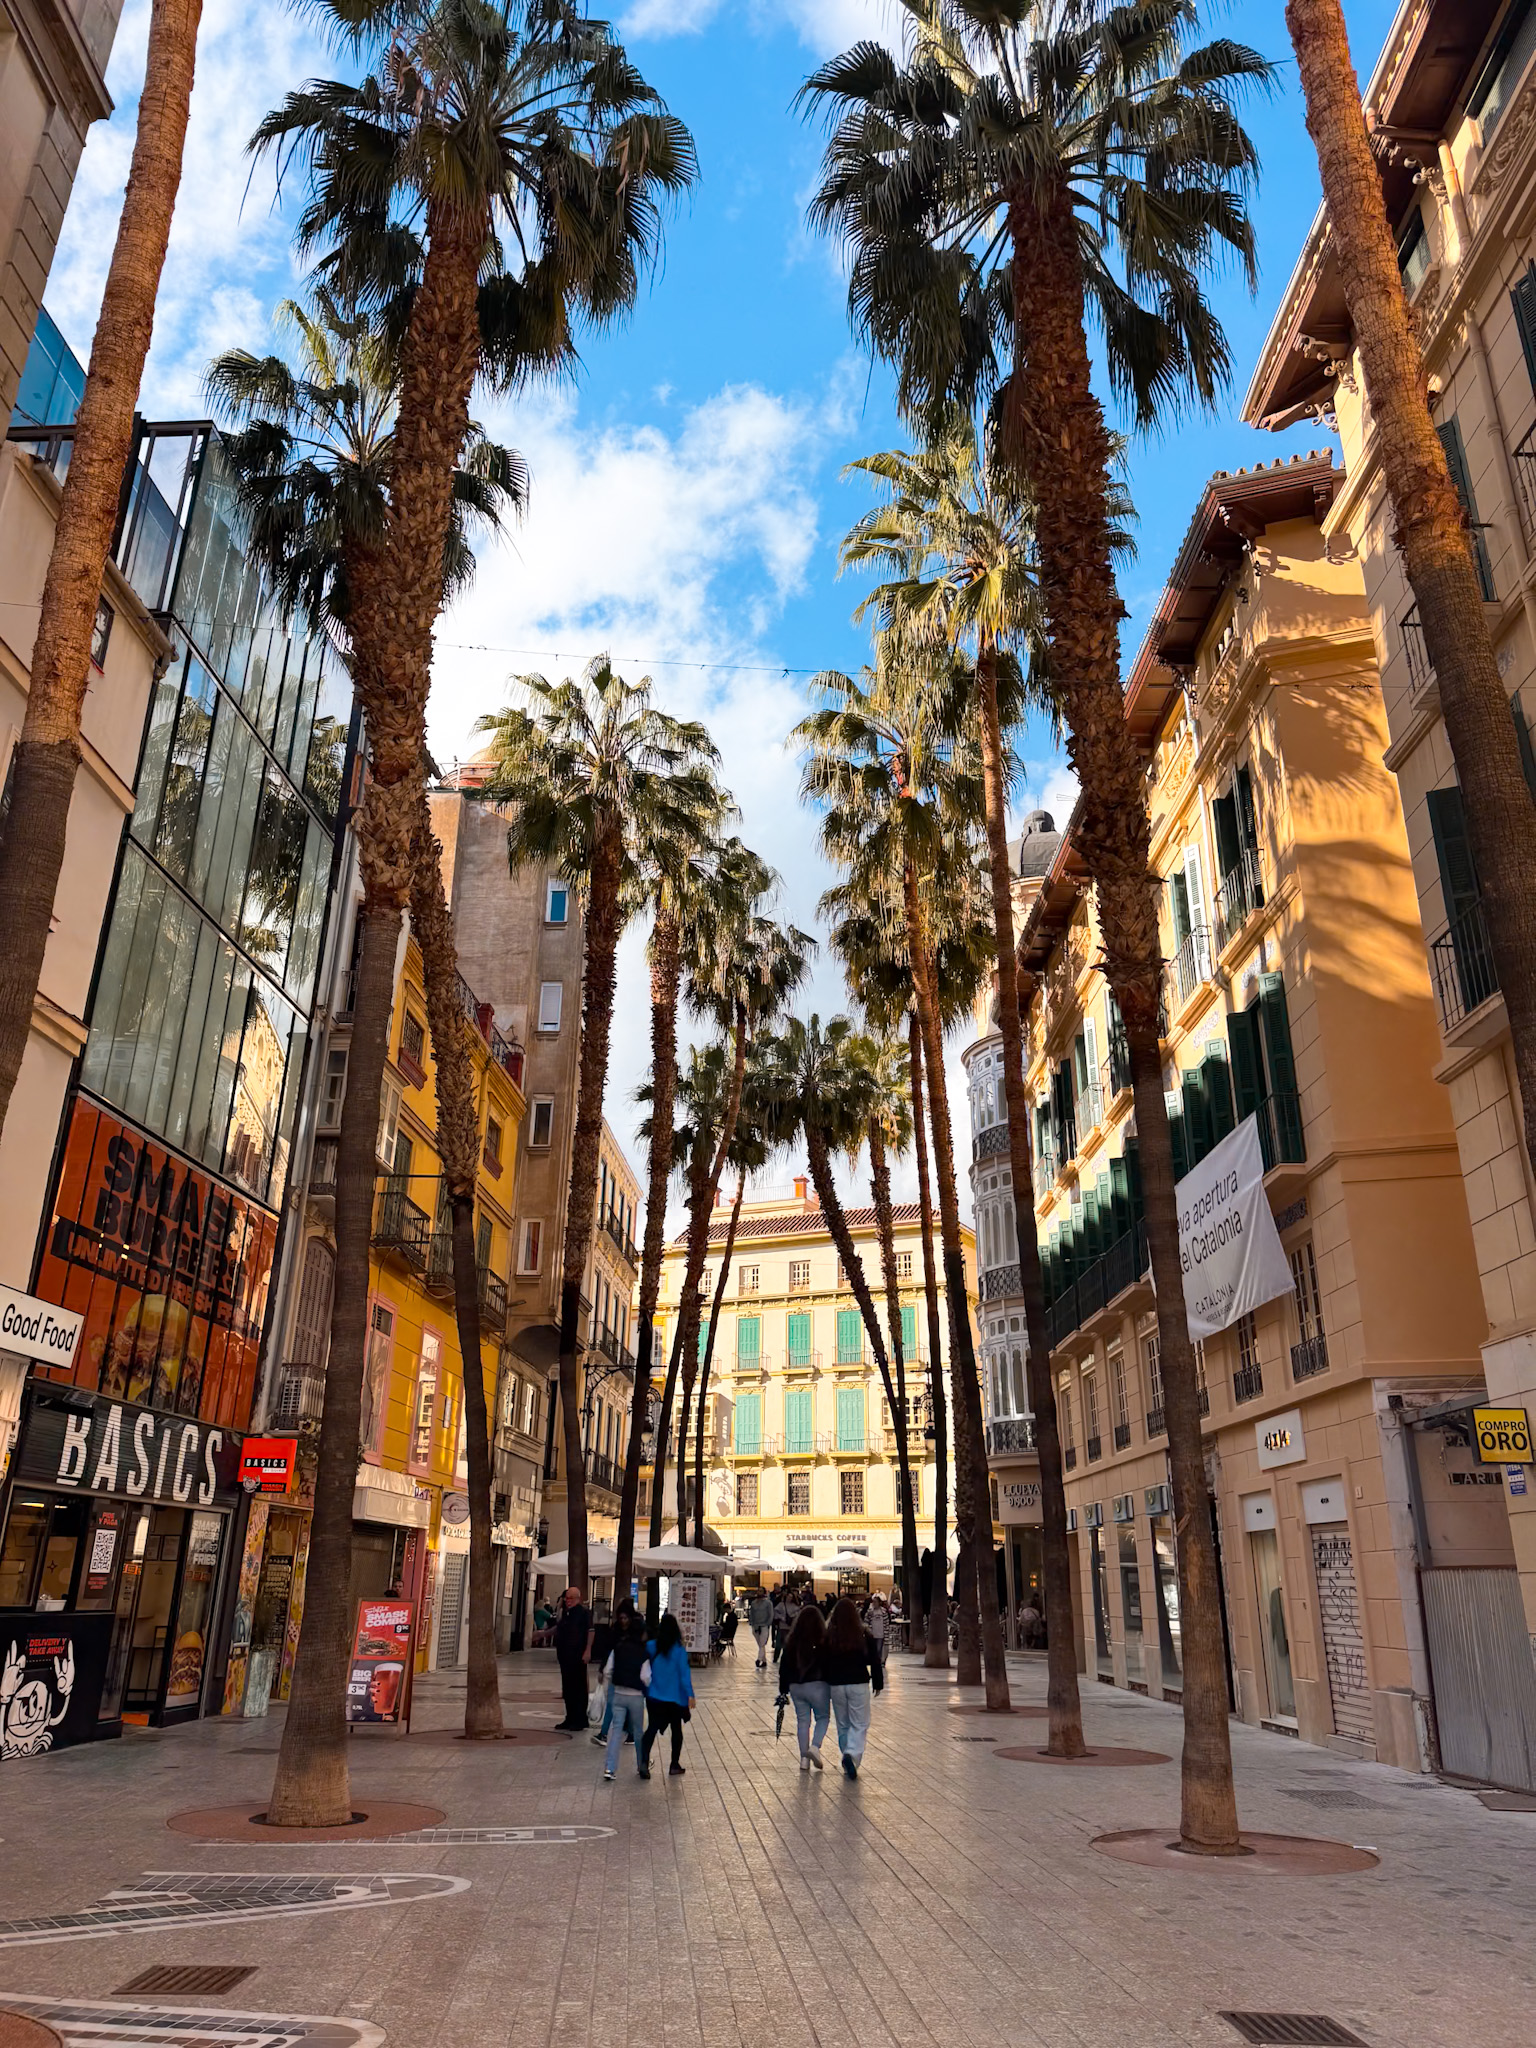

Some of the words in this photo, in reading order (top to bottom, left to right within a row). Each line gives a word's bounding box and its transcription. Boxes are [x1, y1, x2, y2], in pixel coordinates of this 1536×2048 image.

[1192, 1170, 1239, 1228] apertura
[1191, 1208, 1244, 1265] Catalonia
[1195, 1282, 1236, 1315] CATALONIA
[2, 1303, 43, 1341] Good
[40, 1315, 78, 1352] Food
[1478, 1421, 1526, 1431] COMPRO
[1480, 1431, 1528, 1451] ORO
[56, 1404, 223, 1506] BASICS
[246, 1458, 286, 1467] BASICS
[1010, 1483, 1041, 1495] CUEVA
[786, 1534, 833, 1542] STARBUCKS
[193, 1553, 217, 1566] FRIES
[366, 1609, 409, 1621] SMASH
[365, 1616, 408, 1628] COMBO
[29, 1638, 61, 1647] DELIVERY
[29, 1647, 46, 1656] TAKE
[46, 1646, 65, 1654] AWAY
[352, 1669, 372, 1677] BIG
